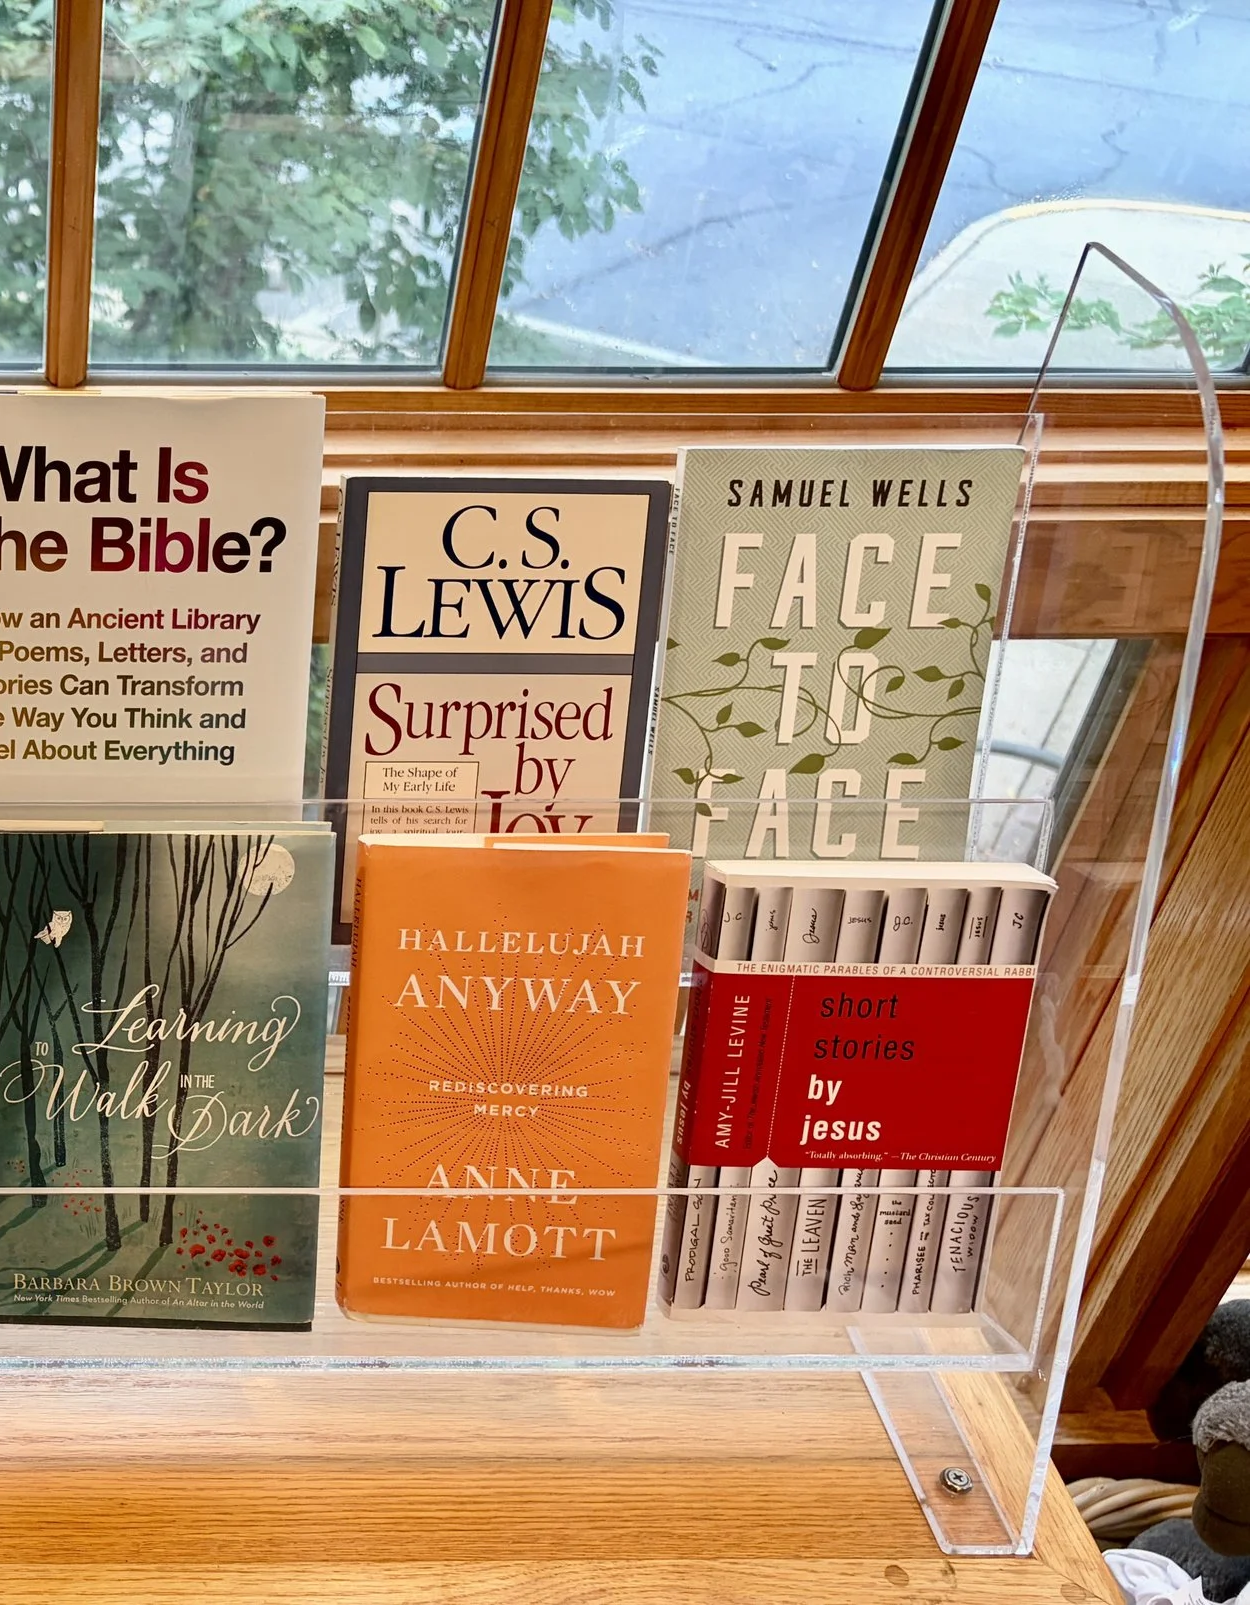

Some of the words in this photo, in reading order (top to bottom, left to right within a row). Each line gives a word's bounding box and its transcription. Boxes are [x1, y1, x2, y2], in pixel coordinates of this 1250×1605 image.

[158, 447, 209, 504] Is
[728, 480, 850, 507] SAMUEL
[872, 480, 973, 507] WELLS
[91, 517, 287, 573] Bible?
[713, 533, 962, 629] FACE
[372, 566, 626, 640] LEWIS
[30, 612, 60, 628] an
[68, 609, 164, 629] Ancient
[172, 609, 261, 634] Library
[771, 652, 879, 745] TO
[12, 707, 65, 732] Way
[71, 707, 117, 728] You
[124, 708, 192, 729] Think
[199, 709, 246, 729] and
[365, 683, 613, 756] Surprised
[382, 767, 404, 777] The
[407, 767, 442, 781] Shape
[445, 767, 458, 777] of
[382, 782, 400, 793] My
[403, 782, 432, 794] Early
[435, 782, 456, 792] Life
[514, 742, 575, 810] by
[692, 769, 926, 859] FACE
[398, 929, 645, 957] HALLELUJAH
[737, 963, 756, 973] THE
[761, 964, 820, 974] ENIGMATIC
[824, 965, 878, 975] PARABLES
[883, 966, 897, 975] OF
[900, 966, 907, 975] A
[911, 966, 1000, 976] CONTROVERSIAL
[394, 974, 642, 1015] ANYWAY
[820, 993, 898, 1018] short
[72, 984, 301, 1072] Learning
[726, 995, 750, 1059] LEVINE
[35, 1041, 48, 1056] TO
[814, 1035, 915, 1060] stories
[0, 1061, 172, 1123] Walk
[180, 1074, 193, 1088] IN
[194, 1074, 215, 1088] THE
[429, 1080, 588, 1098] REDISCOVERING
[808, 1074, 843, 1105] by
[474, 1104, 540, 1117] MERCY
[715, 1067, 739, 1149] AMY-JILL
[151, 1089, 319, 1159] Dark
[800, 1115, 882, 1145] jesus
[426, 1164, 577, 1205] ANNE
[381, 1218, 617, 1261] LAMOTT
[13, 1274, 100, 1291] BARBARA
[109, 1275, 181, 1293] BROWN
[185, 1278, 263, 1296] TAYLOR
[373, 1277, 441, 1288] BESTSELLING
[445, 1281, 487, 1290] AUTHOR
